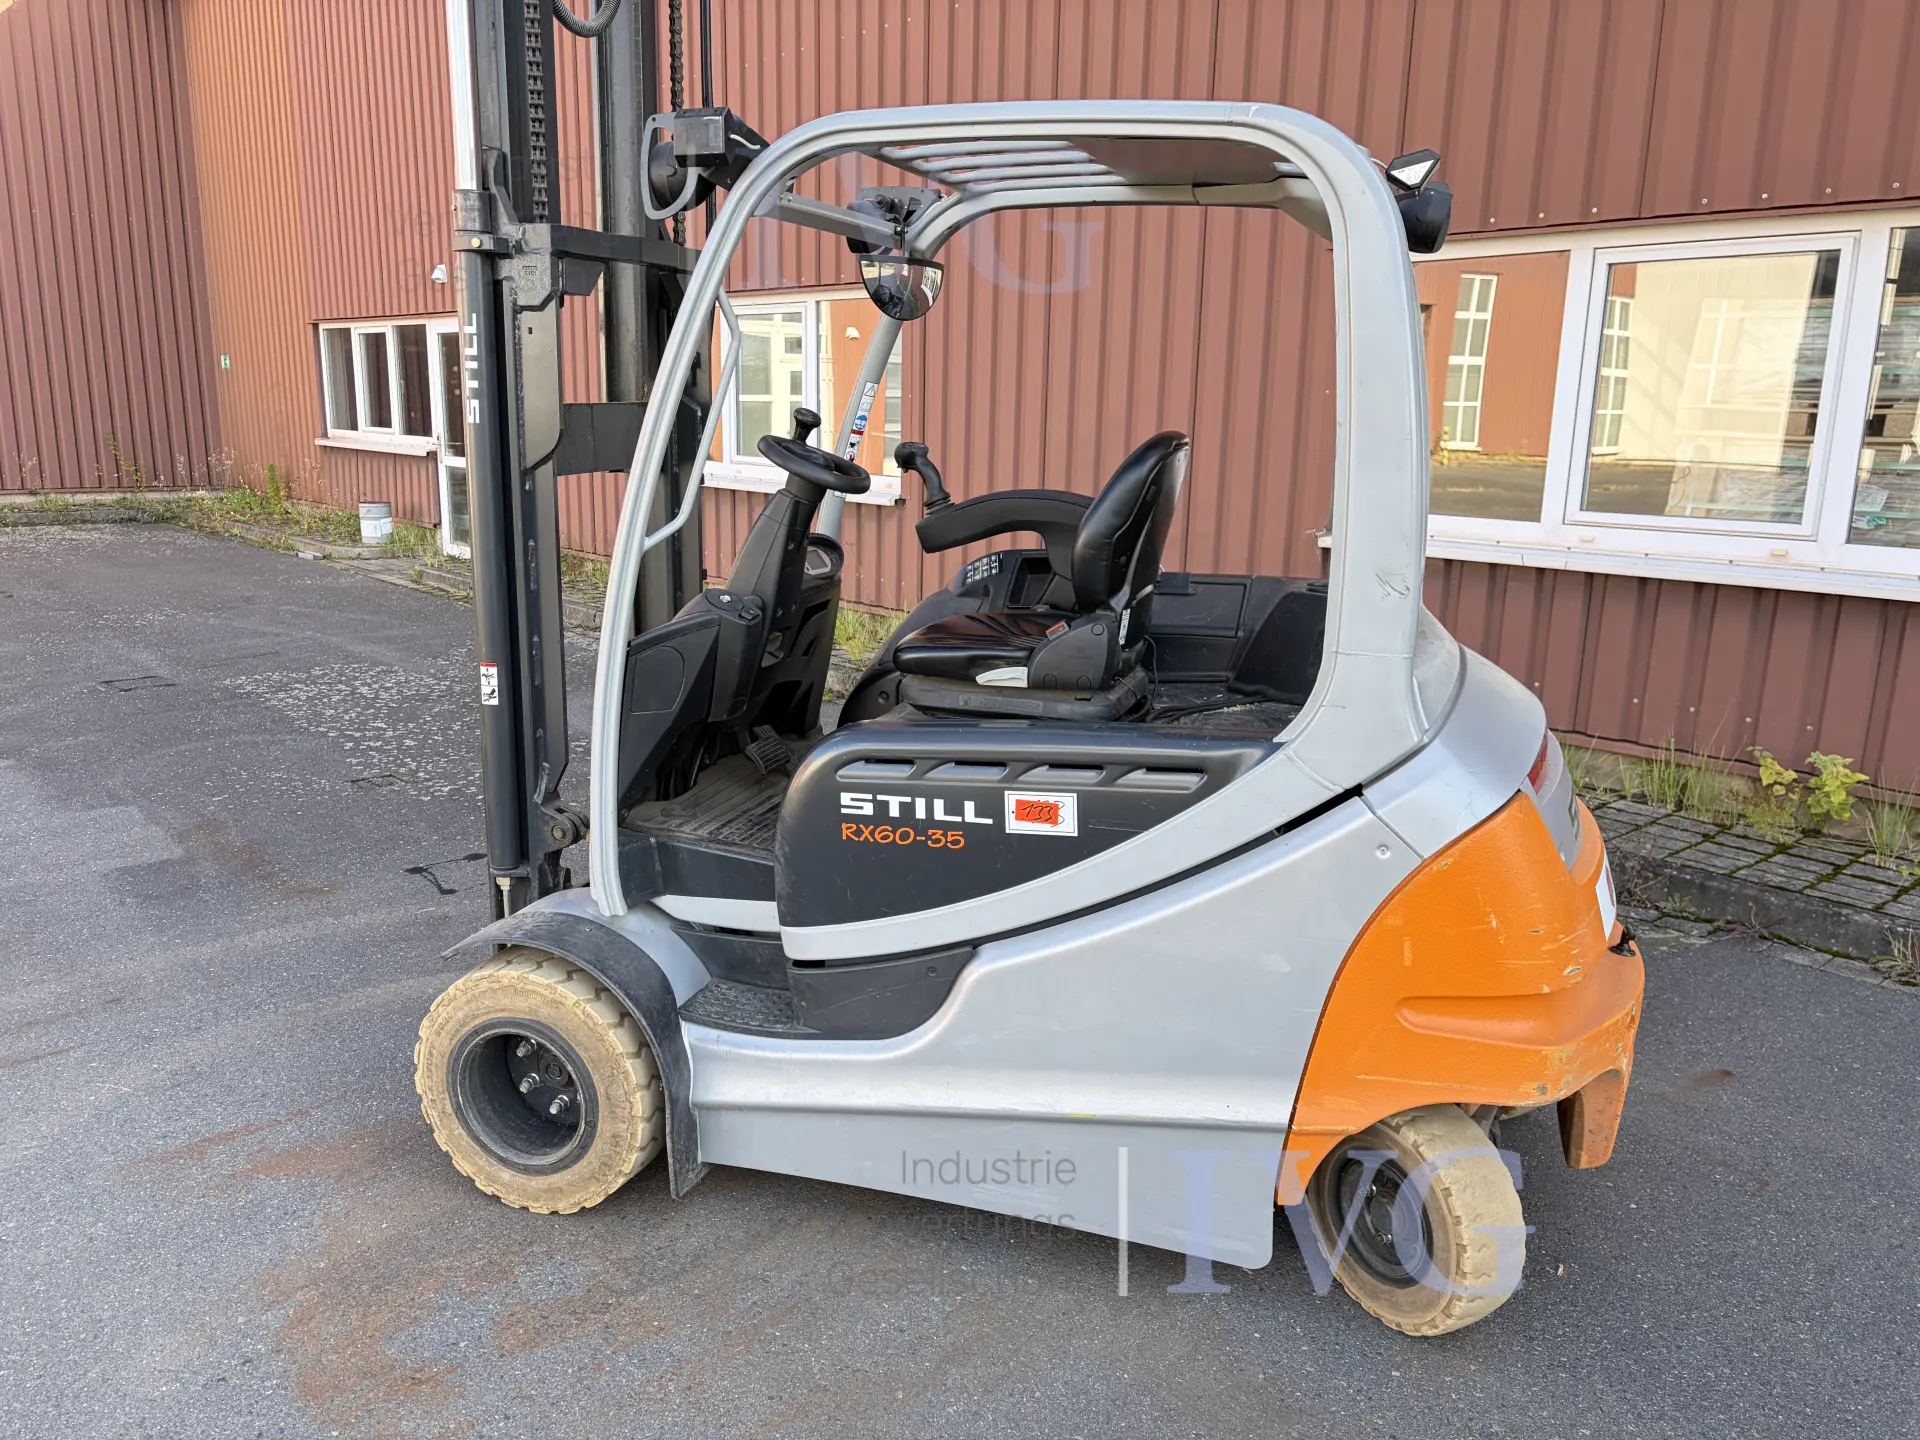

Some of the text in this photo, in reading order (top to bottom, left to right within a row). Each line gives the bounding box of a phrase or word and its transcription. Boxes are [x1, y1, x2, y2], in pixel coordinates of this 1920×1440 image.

[463, 313, 480, 423] STILL
[840, 792, 993, 824] STILL
[1021, 804, 1053, 822] 133
[841, 823, 965, 849] RX60-35
